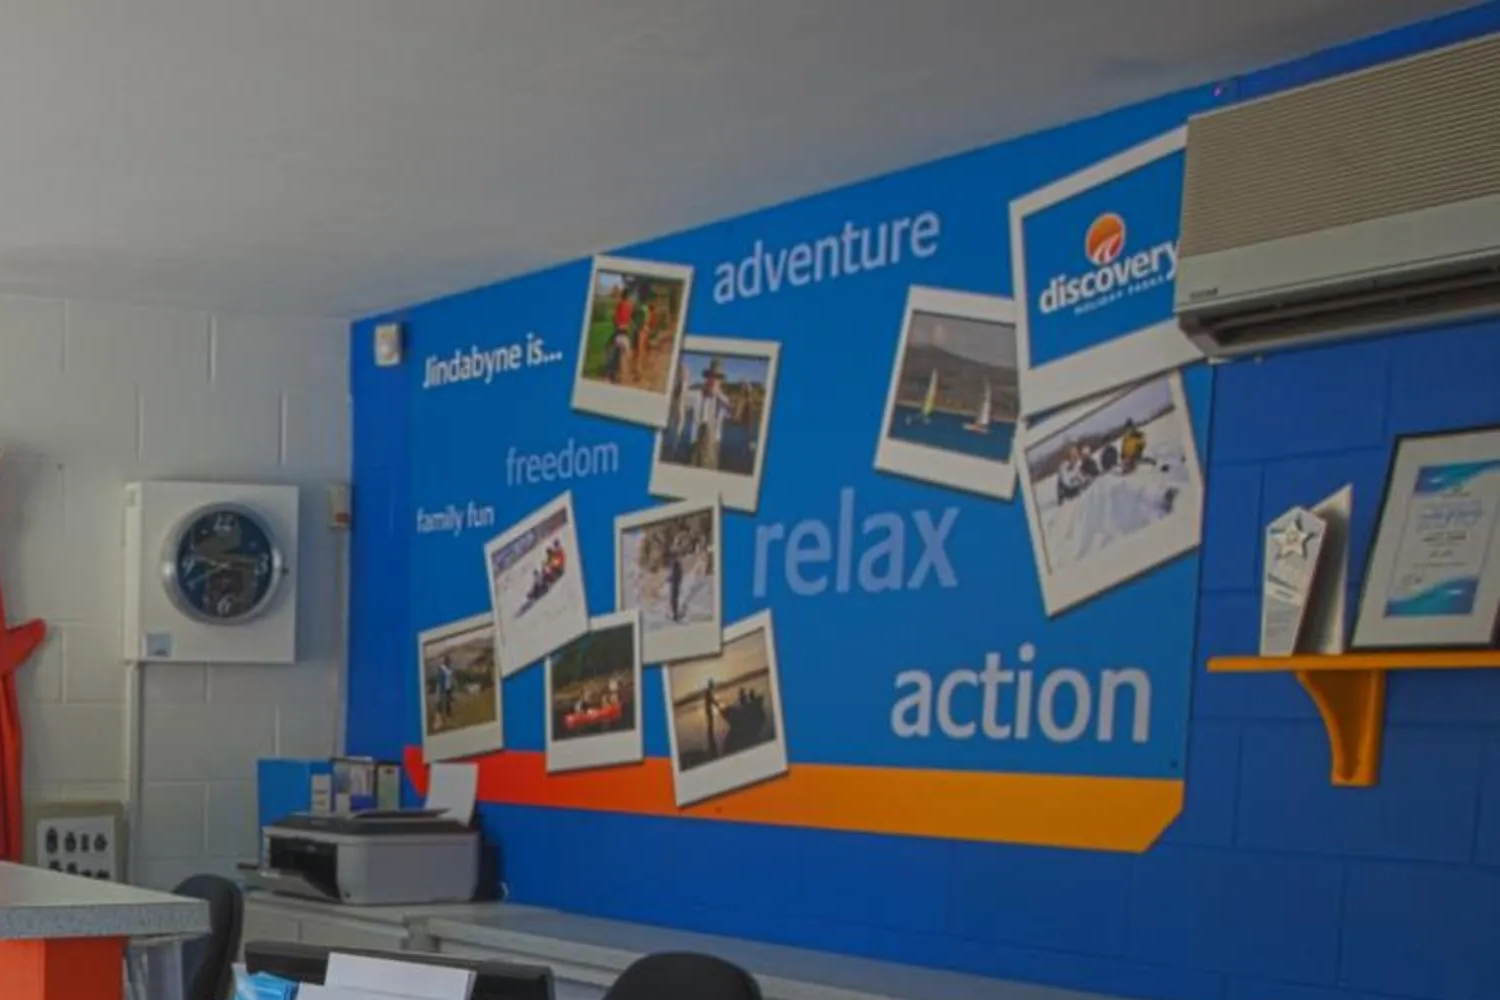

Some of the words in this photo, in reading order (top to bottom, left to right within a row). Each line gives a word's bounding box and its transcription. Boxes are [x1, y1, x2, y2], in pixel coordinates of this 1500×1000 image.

[713, 210, 940, 304] adventure
[1040, 240, 1180, 314] discovery
[422, 343, 522, 389] Jindabyne
[526, 332, 563, 367] is...
[506, 438, 620, 487] freedom
[416, 504, 463, 537] family
[467, 500, 495, 529] fun
[753, 487, 960, 598] relax
[890, 642, 1152, 744] action
